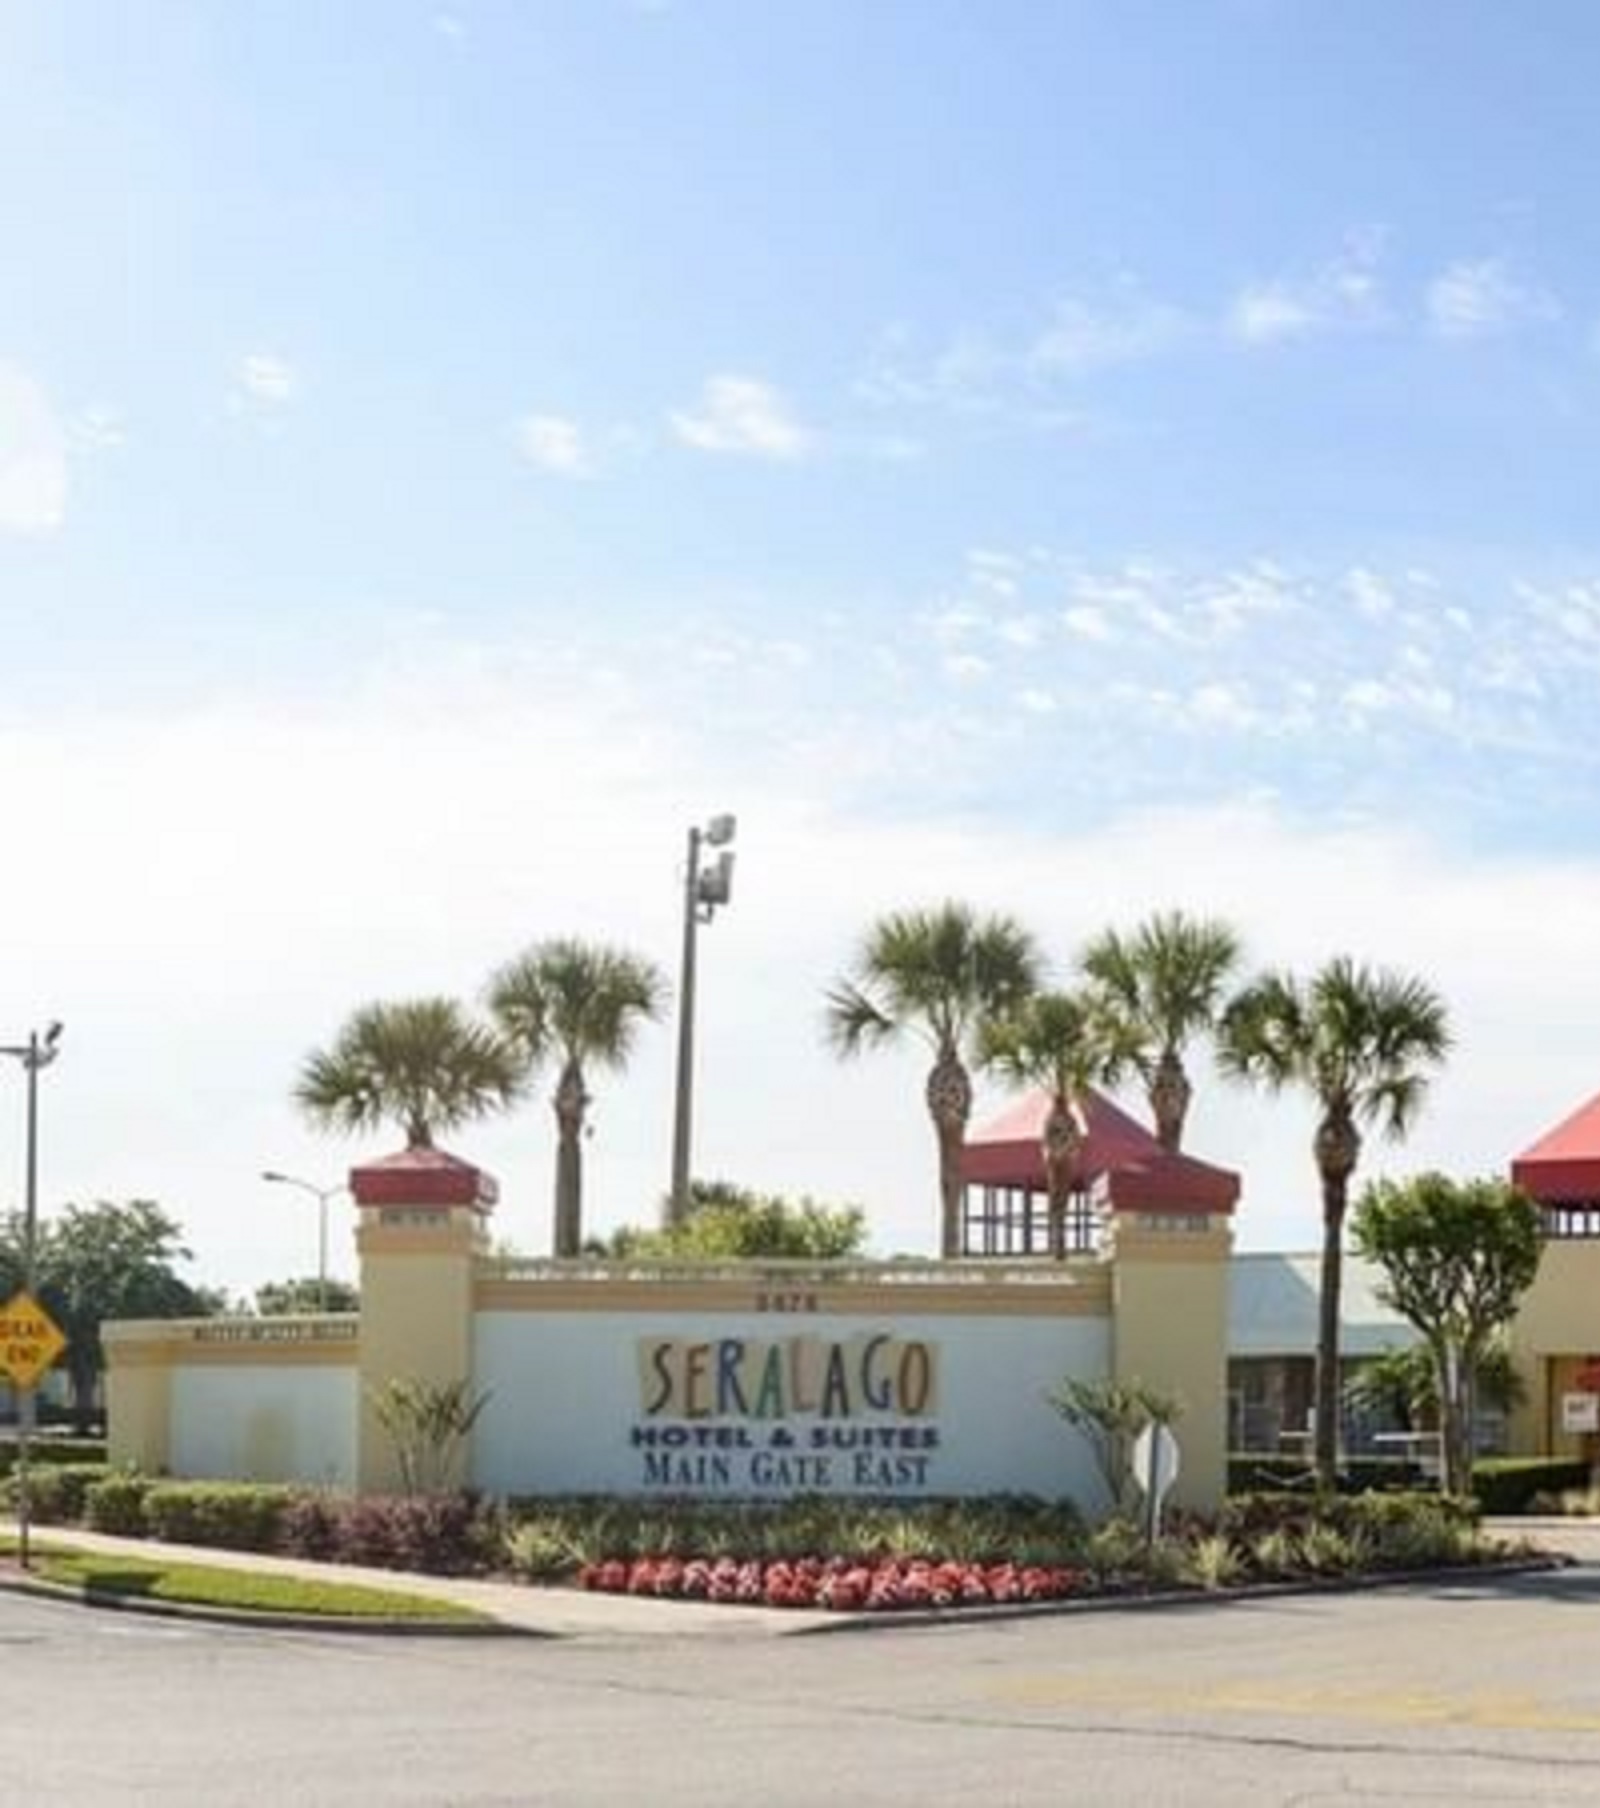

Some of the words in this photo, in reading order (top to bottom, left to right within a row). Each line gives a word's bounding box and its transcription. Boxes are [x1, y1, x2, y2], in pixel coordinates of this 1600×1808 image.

[648, 1335, 930, 1419] SERALAGO
[631, 1427, 752, 1448] HOTEL
[769, 1427, 795, 1448] &
[811, 1427, 939, 1448] SUITES
[643, 1453, 730, 1486] MAIN
[751, 1451, 832, 1487] GATE
[853, 1451, 930, 1487] EAST
